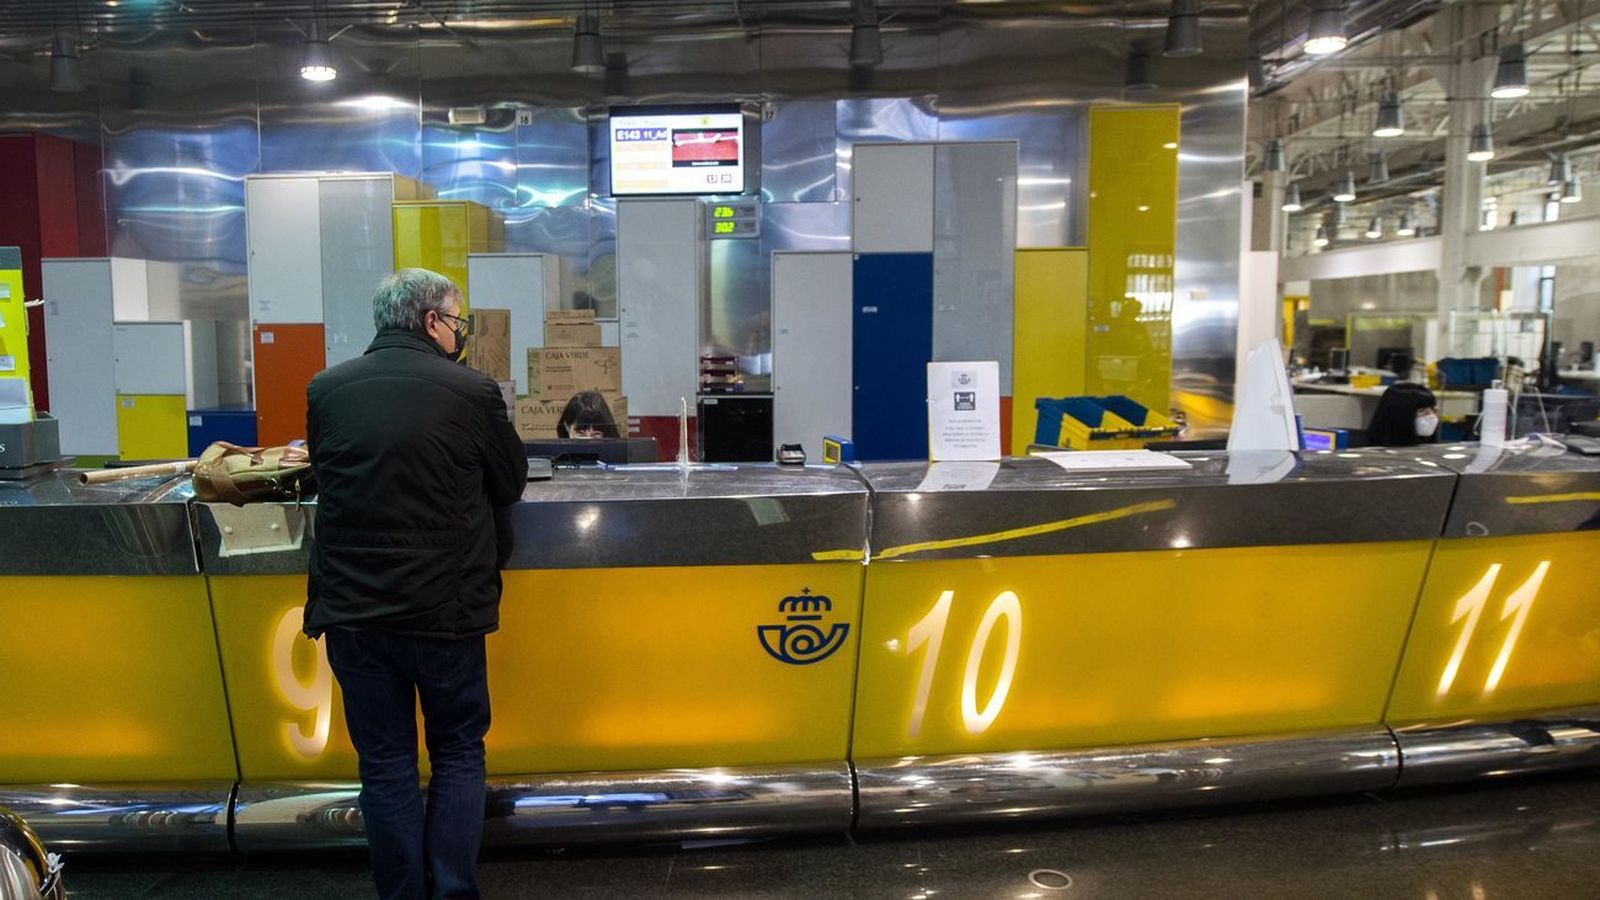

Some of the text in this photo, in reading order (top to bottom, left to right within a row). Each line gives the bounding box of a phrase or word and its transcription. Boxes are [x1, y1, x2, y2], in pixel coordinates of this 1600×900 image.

[617, 130, 640, 140] E143
[545, 351, 589, 361] CAJA VERDE
[521, 406, 565, 416] CAJA VER
[906, 590, 1022, 738] 10
[1432, 561, 1551, 703] 11
[273, 607, 332, 758] 9
